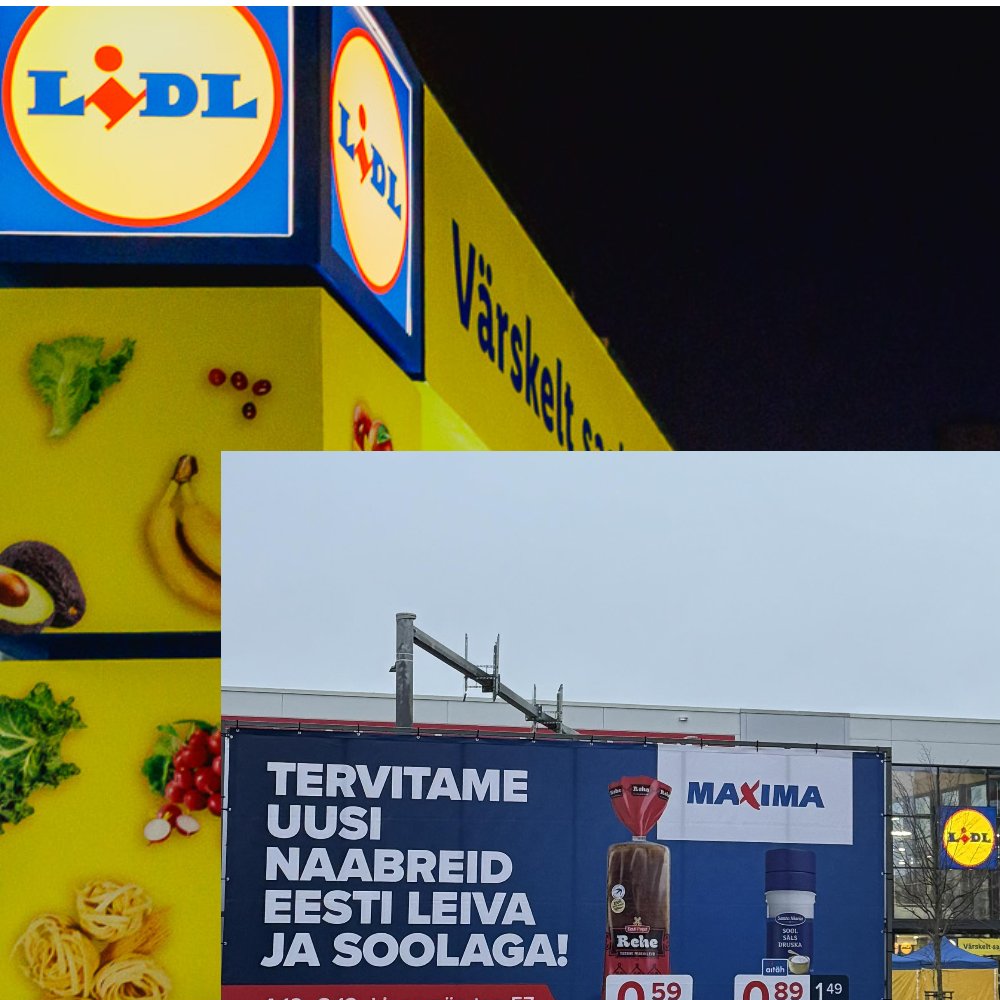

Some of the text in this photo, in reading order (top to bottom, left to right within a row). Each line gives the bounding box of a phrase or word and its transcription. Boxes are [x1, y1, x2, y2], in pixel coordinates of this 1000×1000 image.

[452, 218, 574, 451] Värskelt
[266, 761, 529, 803] TERVITAME
[686, 779, 826, 811] MAXIMA
[267, 804, 382, 841] UUSI
[265, 847, 514, 884] NAABREID
[263, 889, 537, 926] EESTI LEIVA
[260, 932, 569, 968] JA SOOLAGA!
[617, 935, 658, 948] Rehe
[774, 982, 804, 1000] 89
[826, 983, 843, 995] 49
